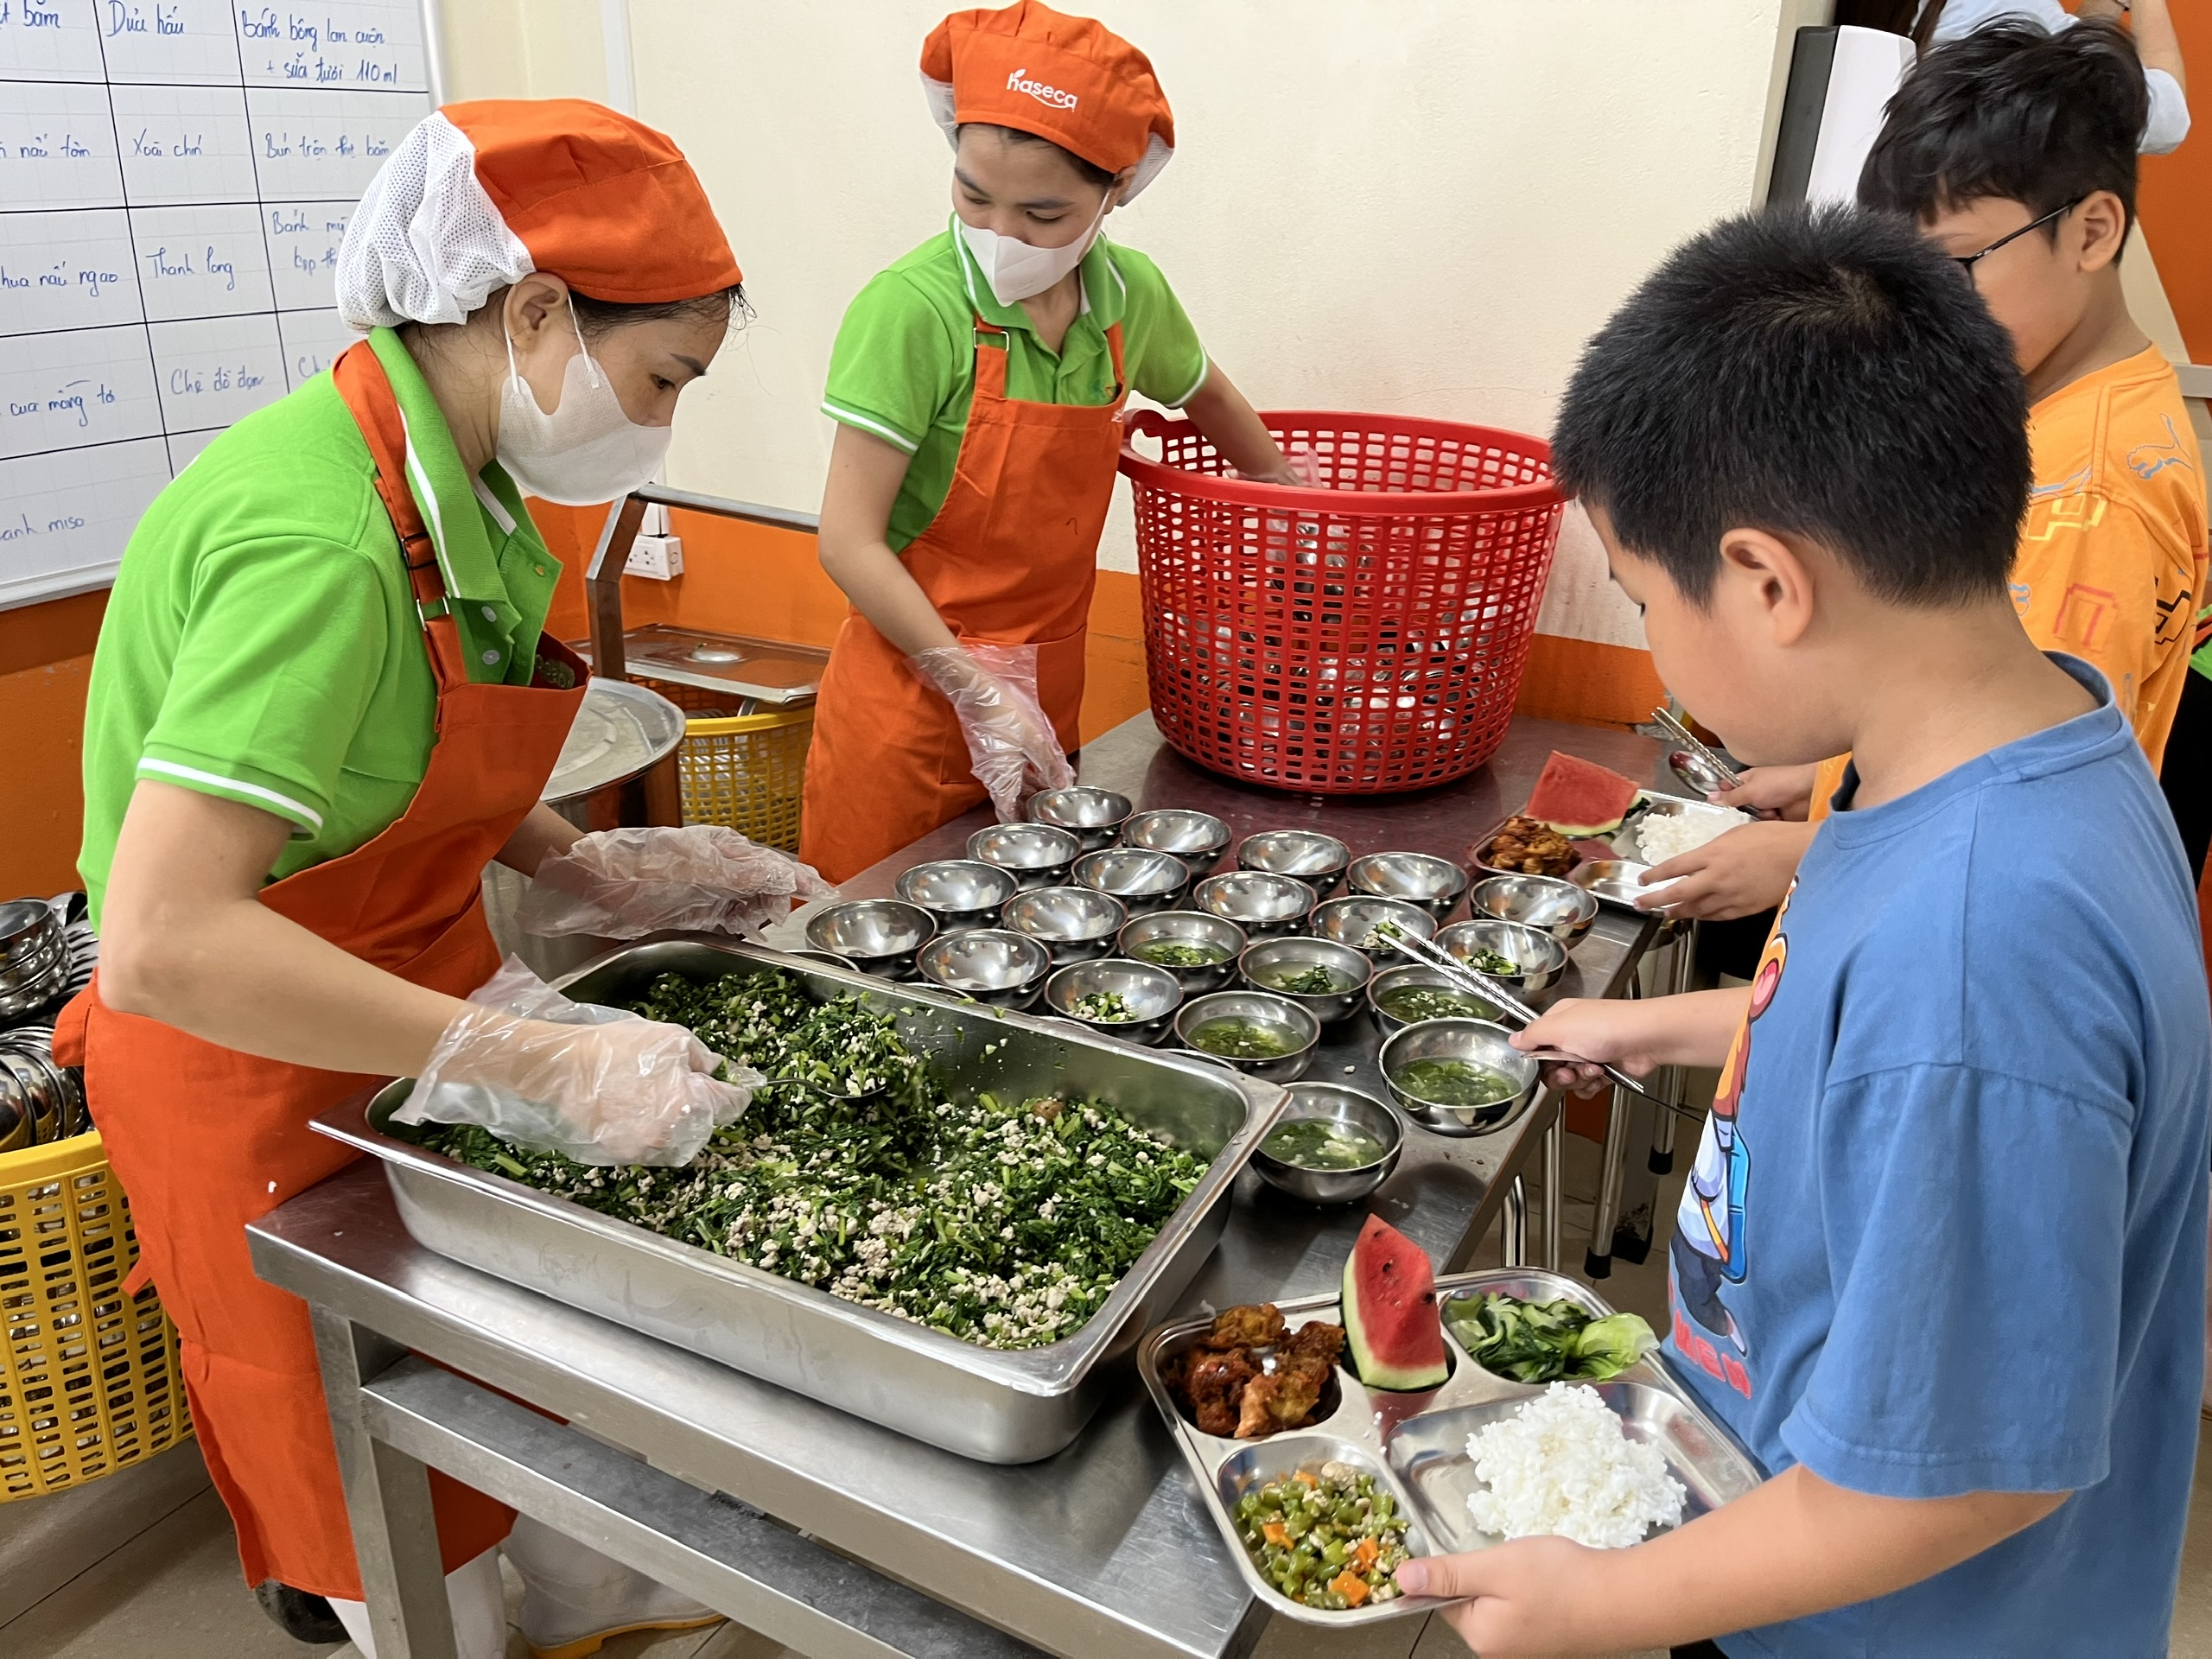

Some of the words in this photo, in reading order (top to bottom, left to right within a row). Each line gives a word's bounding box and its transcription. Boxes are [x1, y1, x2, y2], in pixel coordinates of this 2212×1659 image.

[156, 3, 184, 35] hấu
[289, 14, 318, 53] bông
[327, 17, 347, 42] lan
[283, 52, 308, 79] sữa
[356, 59, 380, 82] 110
[1006, 69, 1078, 112] haseca
[265, 132, 291, 158] Bún
[272, 208, 309, 235] Bánh
[40, 261, 68, 286] nấu
[79, 270, 118, 296] ngao
[145, 247, 195, 279] Thanh
[207, 246, 235, 290] long
[0, 513, 38, 541] anh
[48, 517, 85, 531] miso
